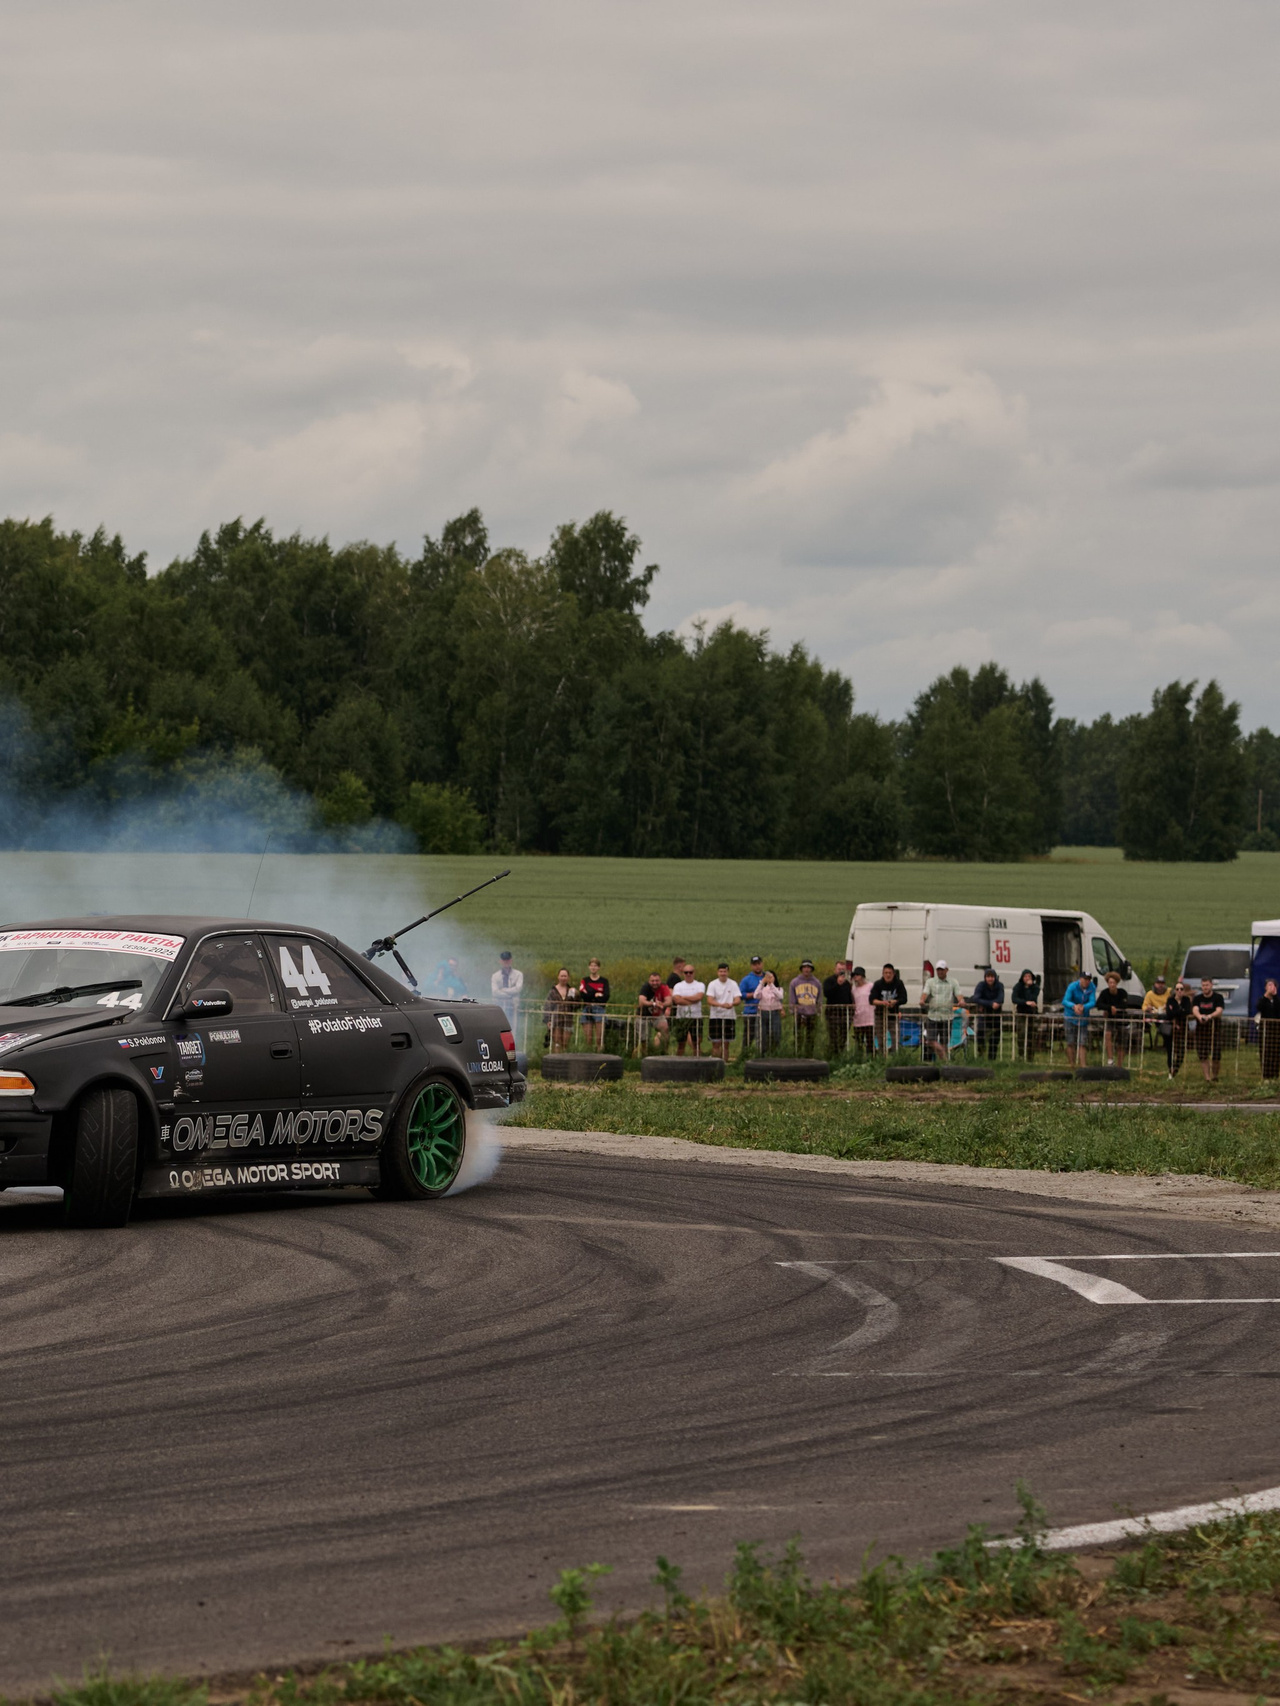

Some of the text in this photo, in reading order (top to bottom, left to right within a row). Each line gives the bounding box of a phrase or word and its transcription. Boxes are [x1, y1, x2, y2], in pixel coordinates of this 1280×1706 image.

[10, 931, 121, 941] БАРНАУЛЬСКОЙ
[120, 932, 183, 948] РАКЕТЫ
[122, 943, 176, 956] СЕЗОН 2025
[279, 945, 332, 996] 44
[96, 991, 143, 1011] 44
[308, 1015, 382, 1034] #PotatoFighter
[127, 1036, 167, 1048] S.Poklonov
[177, 1040, 203, 1055] TARGET
[172, 1108, 385, 1152] OMEGA MOTORS
[238, 1164, 289, 1184] MOTOR
[290, 1162, 341, 1181] SPORT
